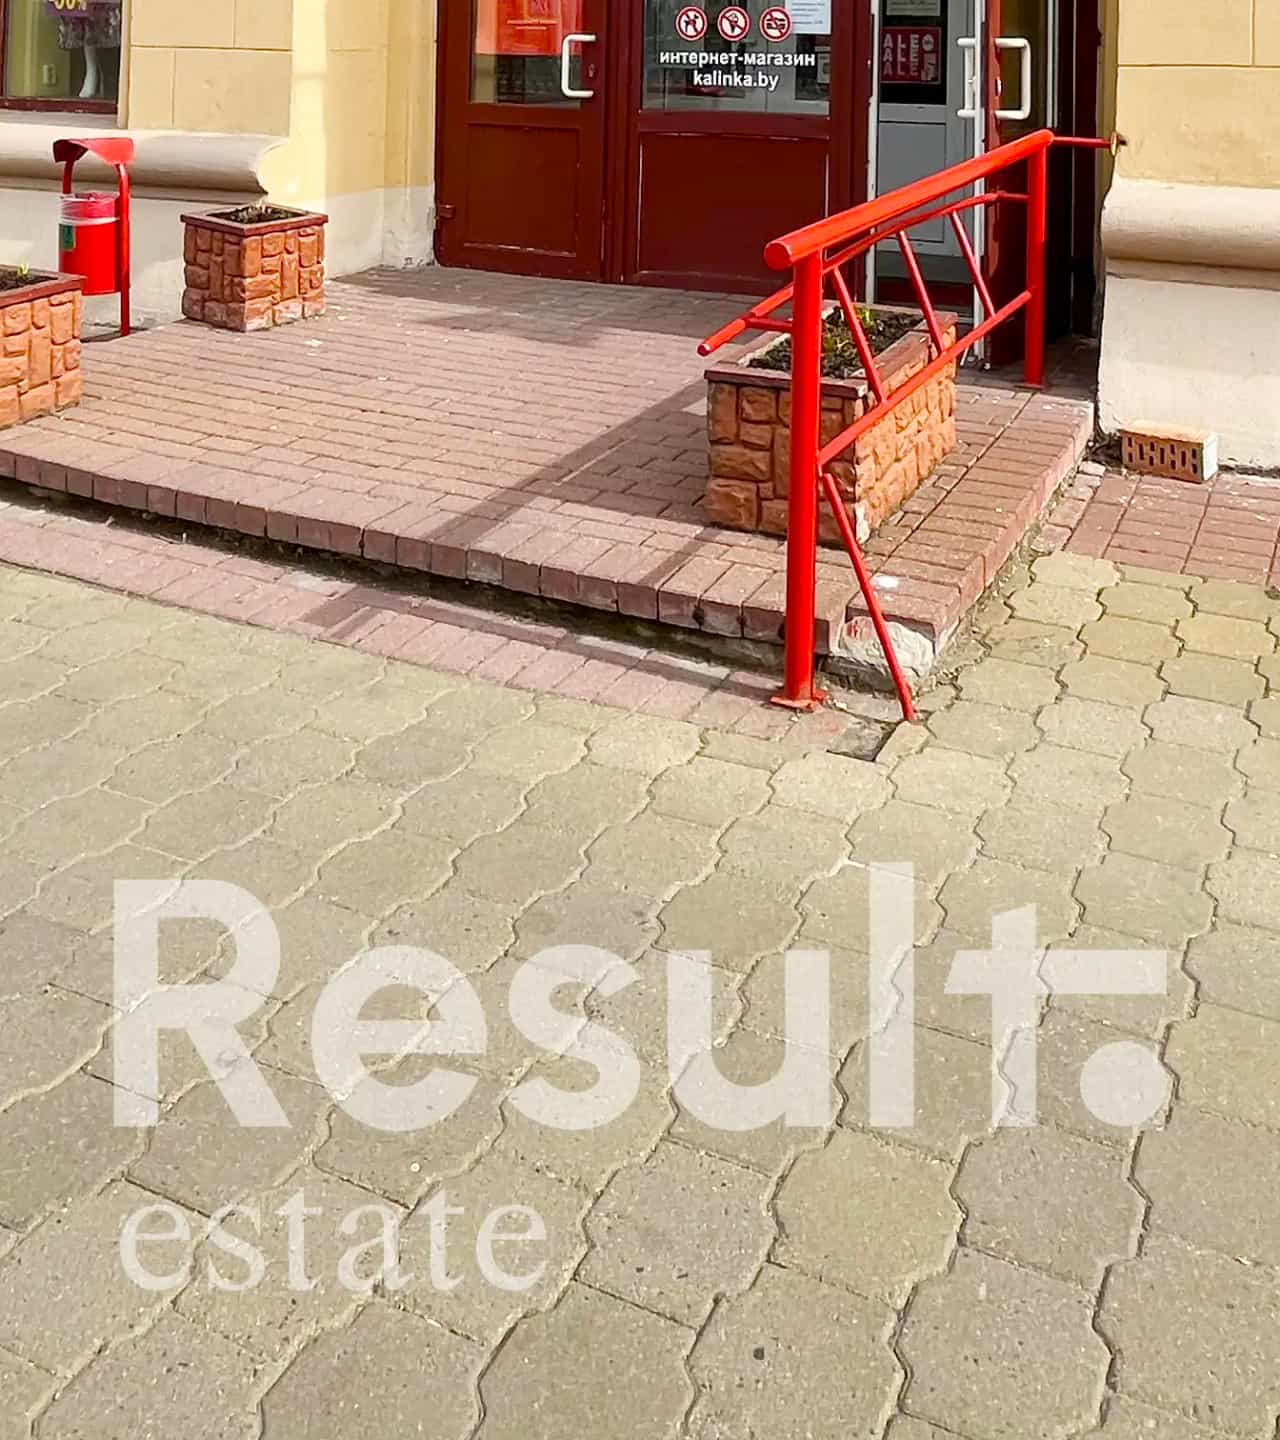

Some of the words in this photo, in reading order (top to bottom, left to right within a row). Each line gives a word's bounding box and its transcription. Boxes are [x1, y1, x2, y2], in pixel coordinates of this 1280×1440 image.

[882, 33, 920, 48] ALE
[660, 51, 815, 68] интернет-магазин
[693, 70, 779, 91] kalinka.by
